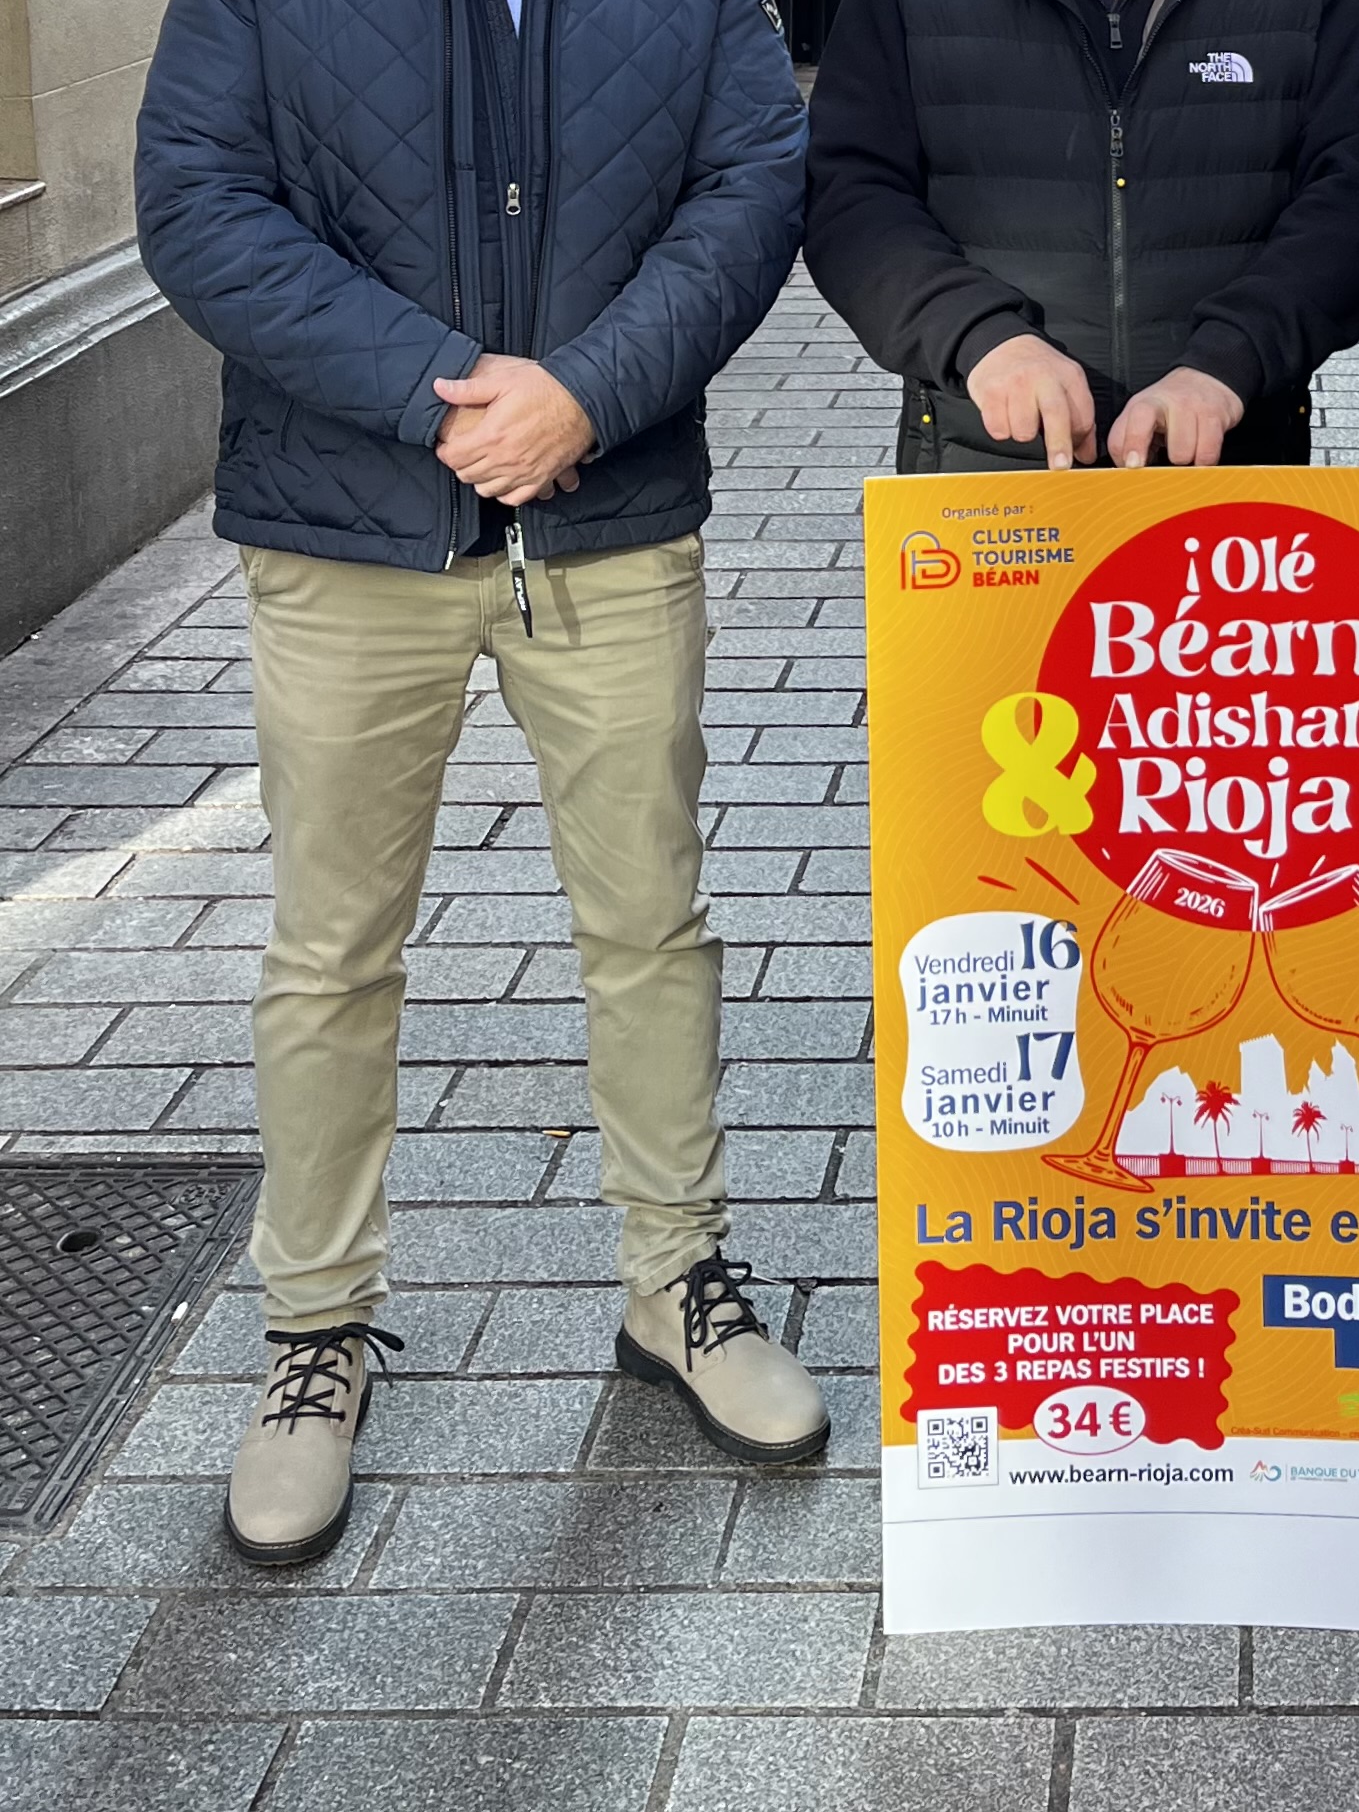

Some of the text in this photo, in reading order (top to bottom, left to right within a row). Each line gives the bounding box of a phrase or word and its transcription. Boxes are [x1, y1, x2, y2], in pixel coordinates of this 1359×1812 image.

[1189, 62, 1232, 73] NORTH
[1207, 52, 1231, 63] THE
[1201, 72, 1232, 83] FACE
[942, 504, 999, 520] Organisé
[1003, 505, 1026, 517] par
[972, 527, 1060, 545] CLUSTER
[972, 547, 1075, 566] TOURISME
[972, 566, 1040, 587] BÉARN
[981, 691, 1097, 838] &
[1173, 887, 1226, 918] 2026
[914, 919, 1081, 975] Vendredi 16
[917, 974, 1050, 1012] janvier
[988, 1004, 1049, 1023] Minuit
[921, 1031, 1076, 1086] Samedi 17
[923, 1084, 1056, 1123] janvier
[990, 1116, 1050, 1136] Minuit
[915, 1202, 973, 1246] La
[993, 1197, 1117, 1252] Rioja
[928, 1302, 1214, 1331] RÉSERVEZ VOTRE PLACE
[1007, 1332, 1075, 1354] POUR
[938, 1362, 986, 1386] DES
[993, 1361, 1008, 1382] 3
[1016, 1358, 1092, 1381] REPAS
[1100, 1357, 1190, 1379] FESTIFS
[1273, 1427, 1341, 1438] Communication
[1009, 1462, 1234, 1486] www.bearn-rioja.com
[1290, 1466, 1338, 1478] BANQUE
[1340, 1469, 1357, 1479] DU
